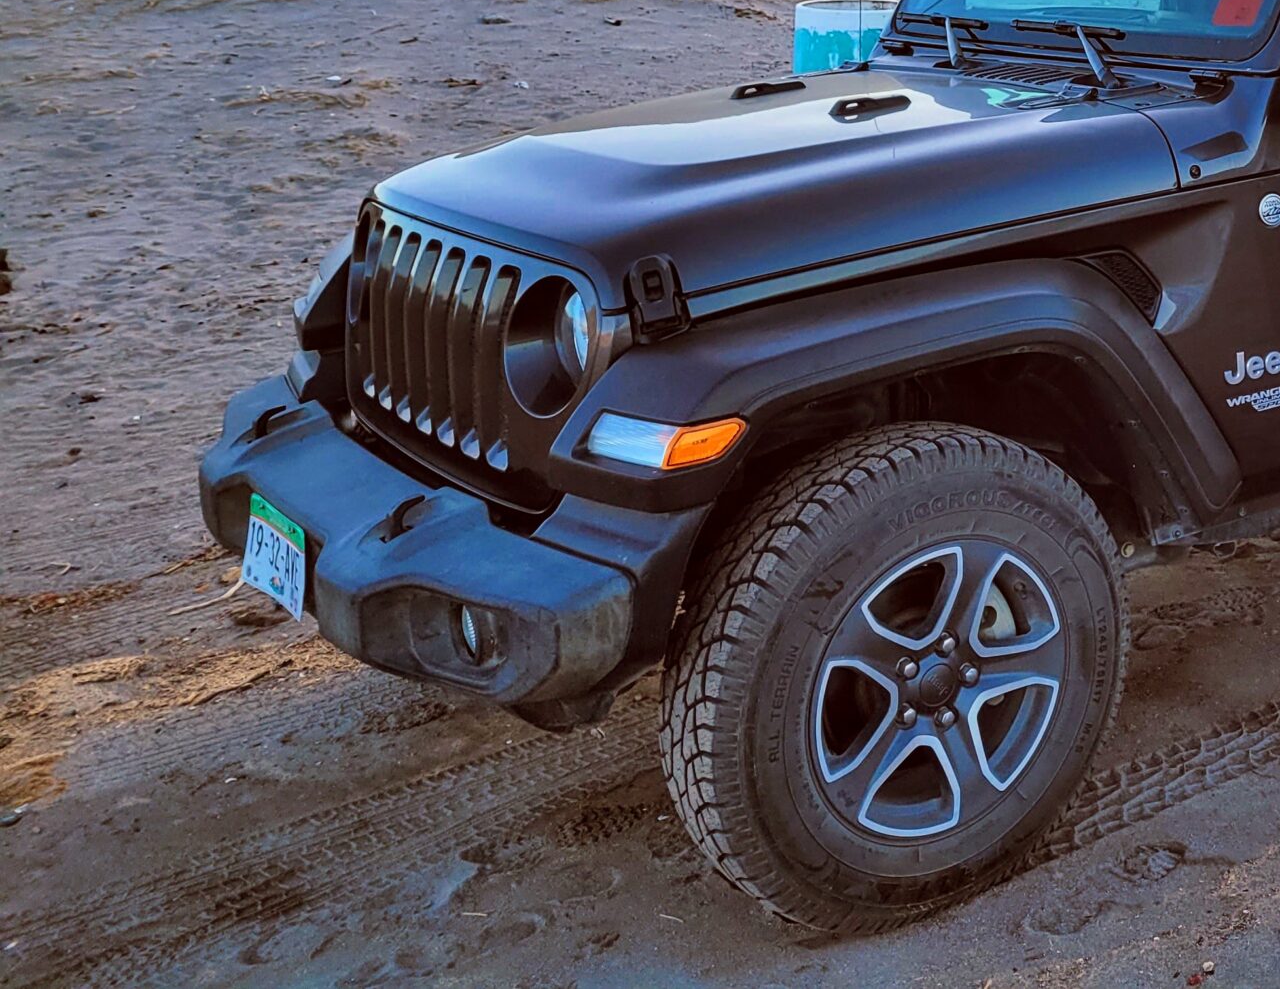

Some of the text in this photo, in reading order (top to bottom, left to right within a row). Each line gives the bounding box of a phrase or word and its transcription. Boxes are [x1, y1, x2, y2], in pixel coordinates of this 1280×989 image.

[887, 489, 1010, 532] VIGOROUS
[250, 521, 300, 591] 19-32-AVE
[767, 644, 800, 763] ALL TERRAIN
